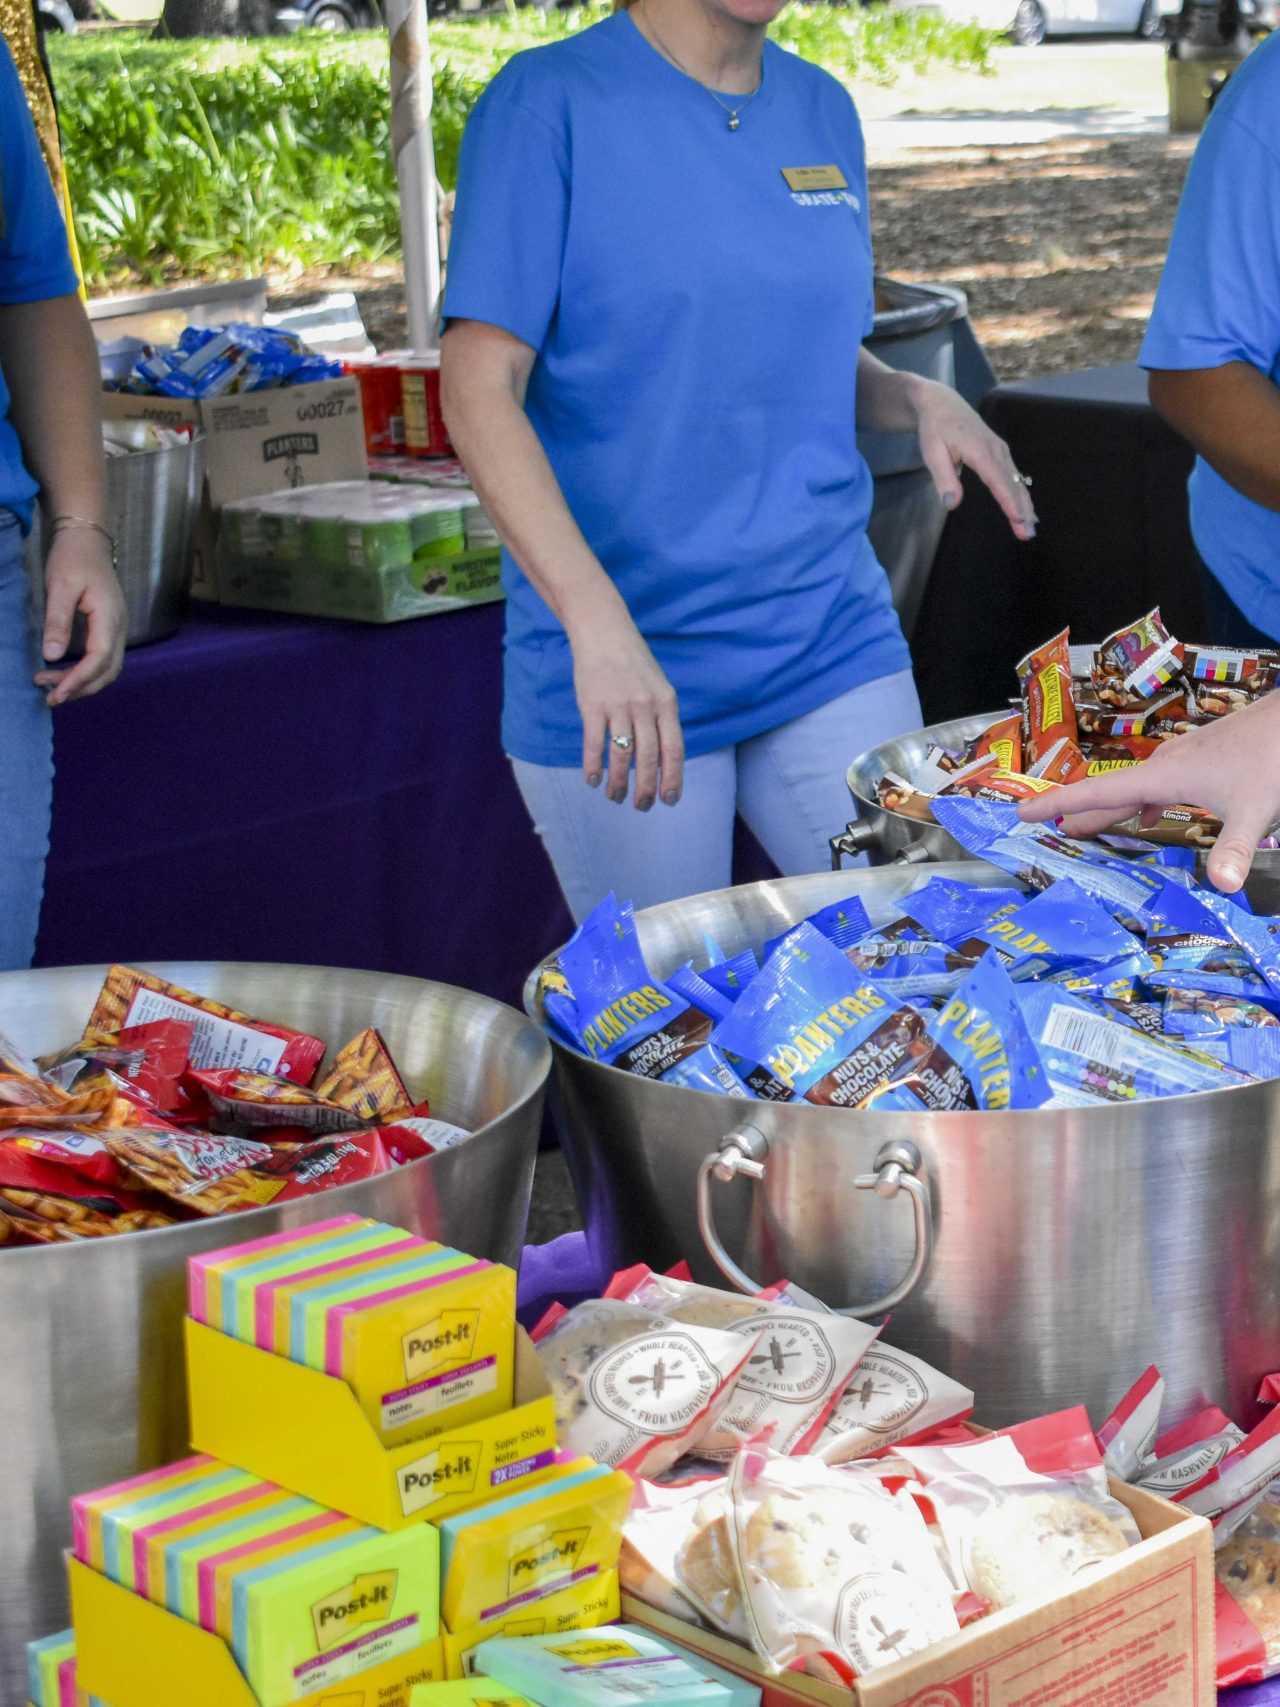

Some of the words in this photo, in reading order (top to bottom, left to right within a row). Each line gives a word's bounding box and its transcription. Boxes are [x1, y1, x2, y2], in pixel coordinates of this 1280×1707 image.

[1162, 809, 1192, 822] Almond
[583, 985, 673, 1059] PLANTERS
[629, 1036, 661, 1062] NUTS
[771, 985, 887, 1089] PLANTERS
[631, 1035, 686, 1075] HOCOLATE
[833, 1052, 870, 1084] NUTS
[865, 1041, 882, 1058] &
[831, 1042, 905, 1105] CHOCOLATE
[409, 1322, 471, 1359] Post-it
[638, 1341, 664, 1353] WHOLE
[388, 1403, 413, 1417] notes
[638, 1411, 668, 1424] FROM
[494, 1435, 518, 1452] Super
[521, 1425, 546, 1442] Sticky
[495, 1451, 519, 1464] Notes
[1170, 1447, 1217, 1480] NASHVILLE
[404, 1455, 473, 1494] Post-it
[494, 1470, 508, 1484] 2X
[319, 1585, 389, 1627] Post-it
[583, 1599, 609, 1614] Sticky
[301, 1670, 327, 1687] notes
[377, 1682, 402, 1698] Super
[405, 1669, 433, 1687] Sticky
